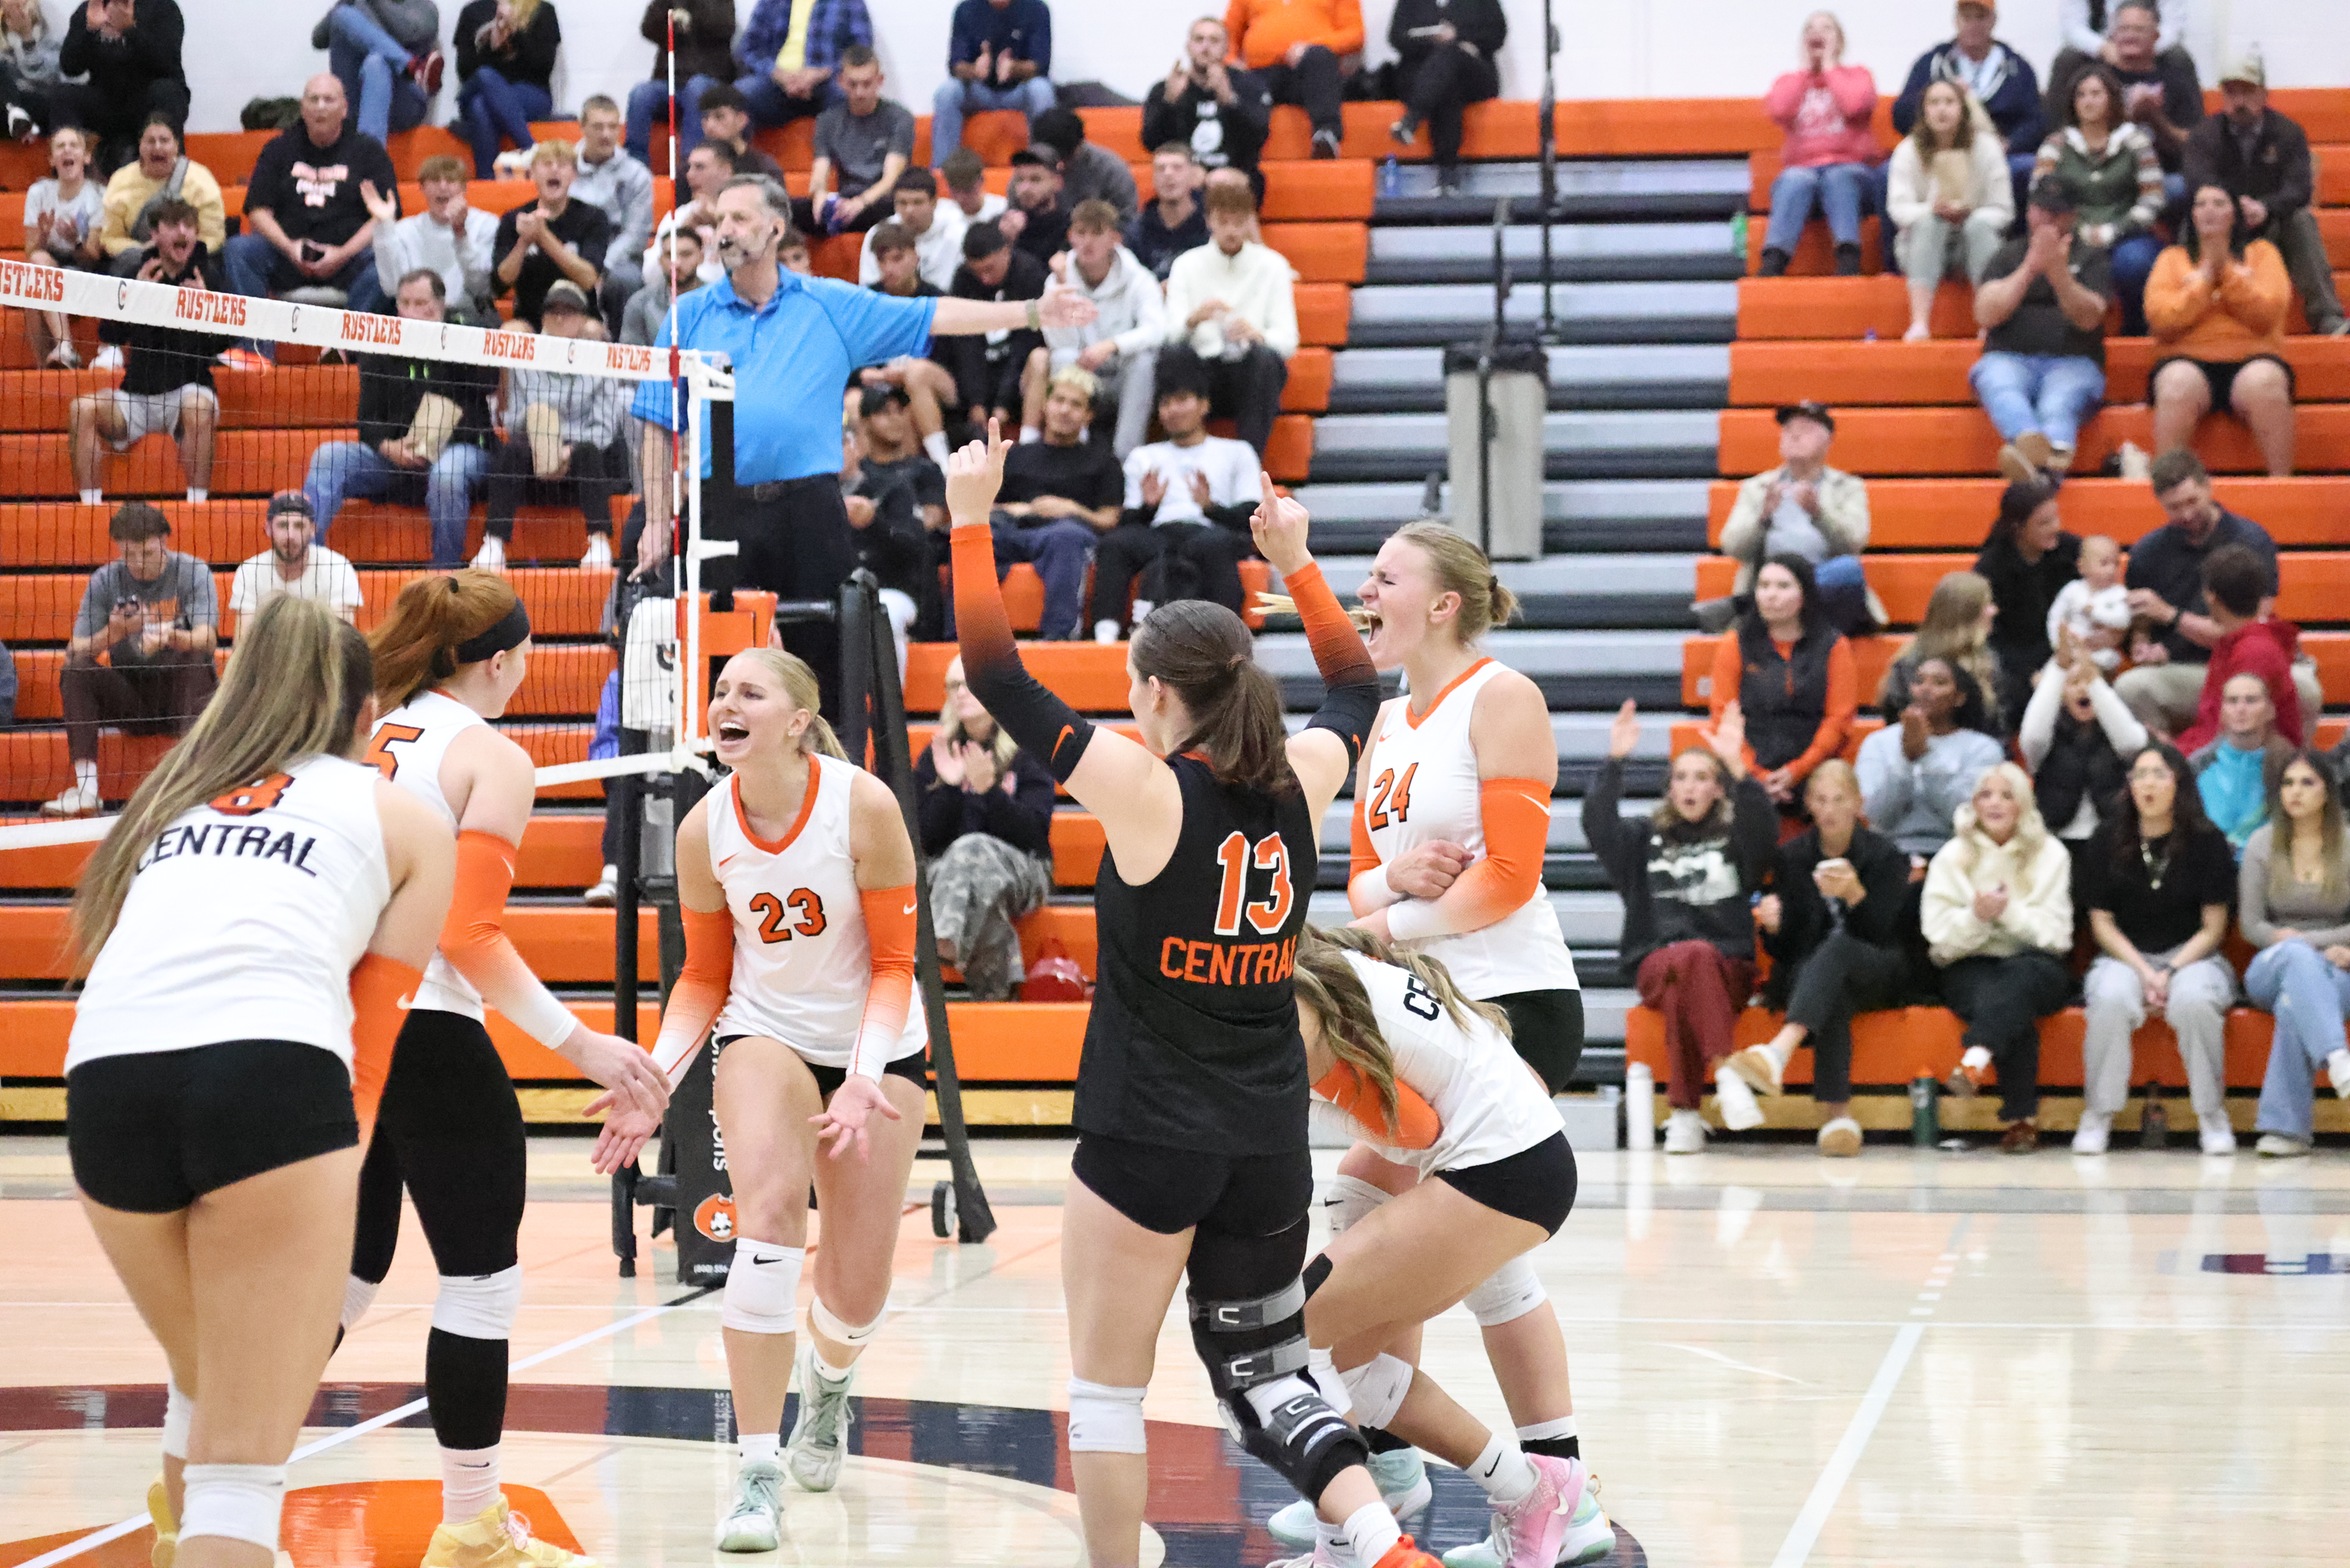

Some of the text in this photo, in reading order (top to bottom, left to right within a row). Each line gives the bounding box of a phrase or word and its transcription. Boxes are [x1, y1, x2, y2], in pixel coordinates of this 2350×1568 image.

[176, 288, 247, 326] RUSTLERS
[340, 312, 402, 345] RUSTLERS
[483, 330, 535, 361] RUSTLERS
[361, 722, 426, 782] 5
[1369, 762, 1419, 832] 24
[1214, 830, 1294, 936] 13
[749, 887, 827, 944] 23
[1159, 934, 1297, 985] CENTRAL
